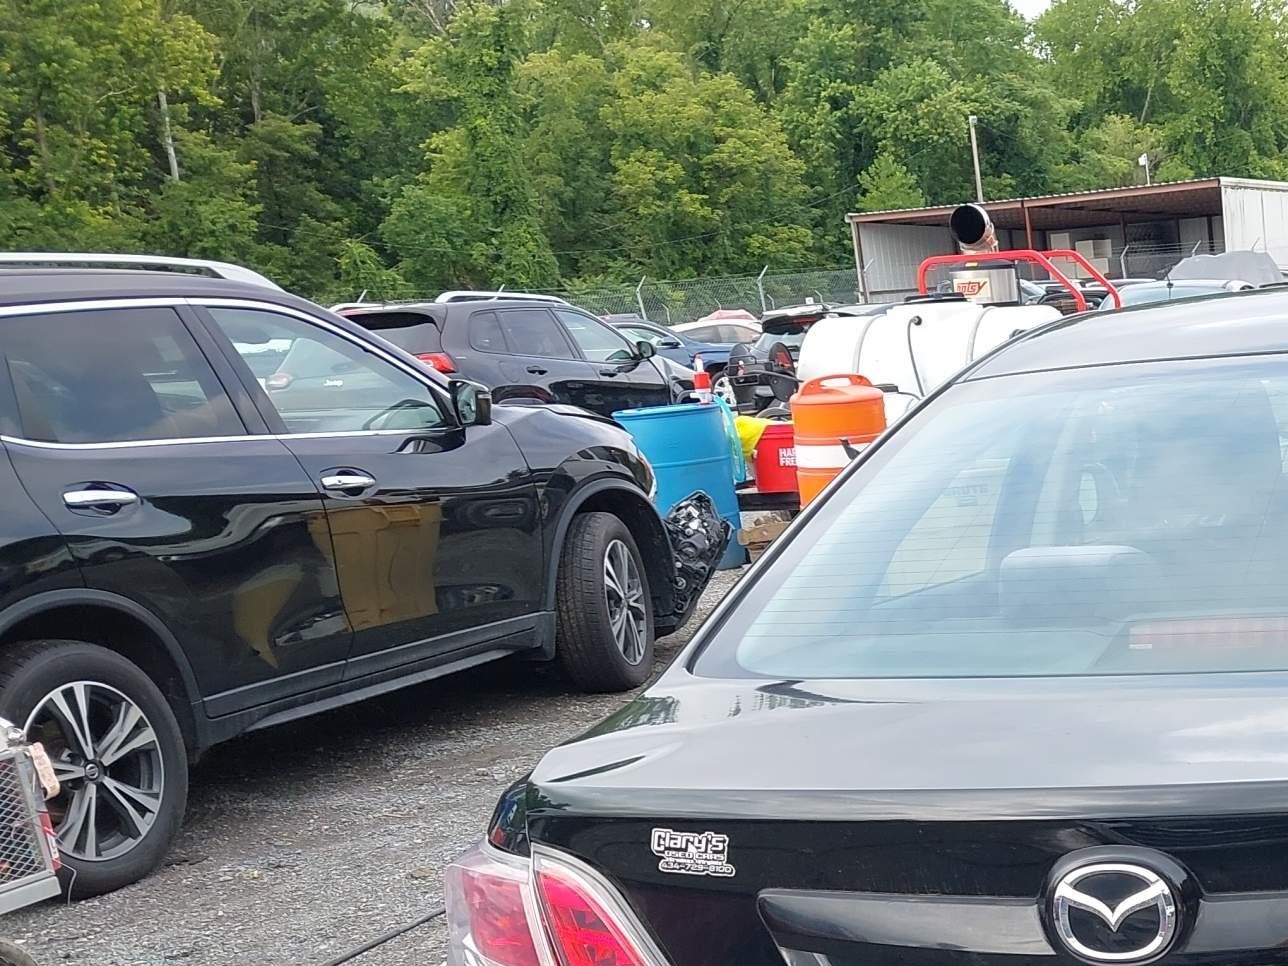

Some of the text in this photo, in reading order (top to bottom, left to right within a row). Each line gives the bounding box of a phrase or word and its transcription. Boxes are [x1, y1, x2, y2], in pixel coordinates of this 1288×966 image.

[653, 831, 724, 852] Clary's
[664, 850, 693, 859] USED
[695, 853, 725, 861] CARS
